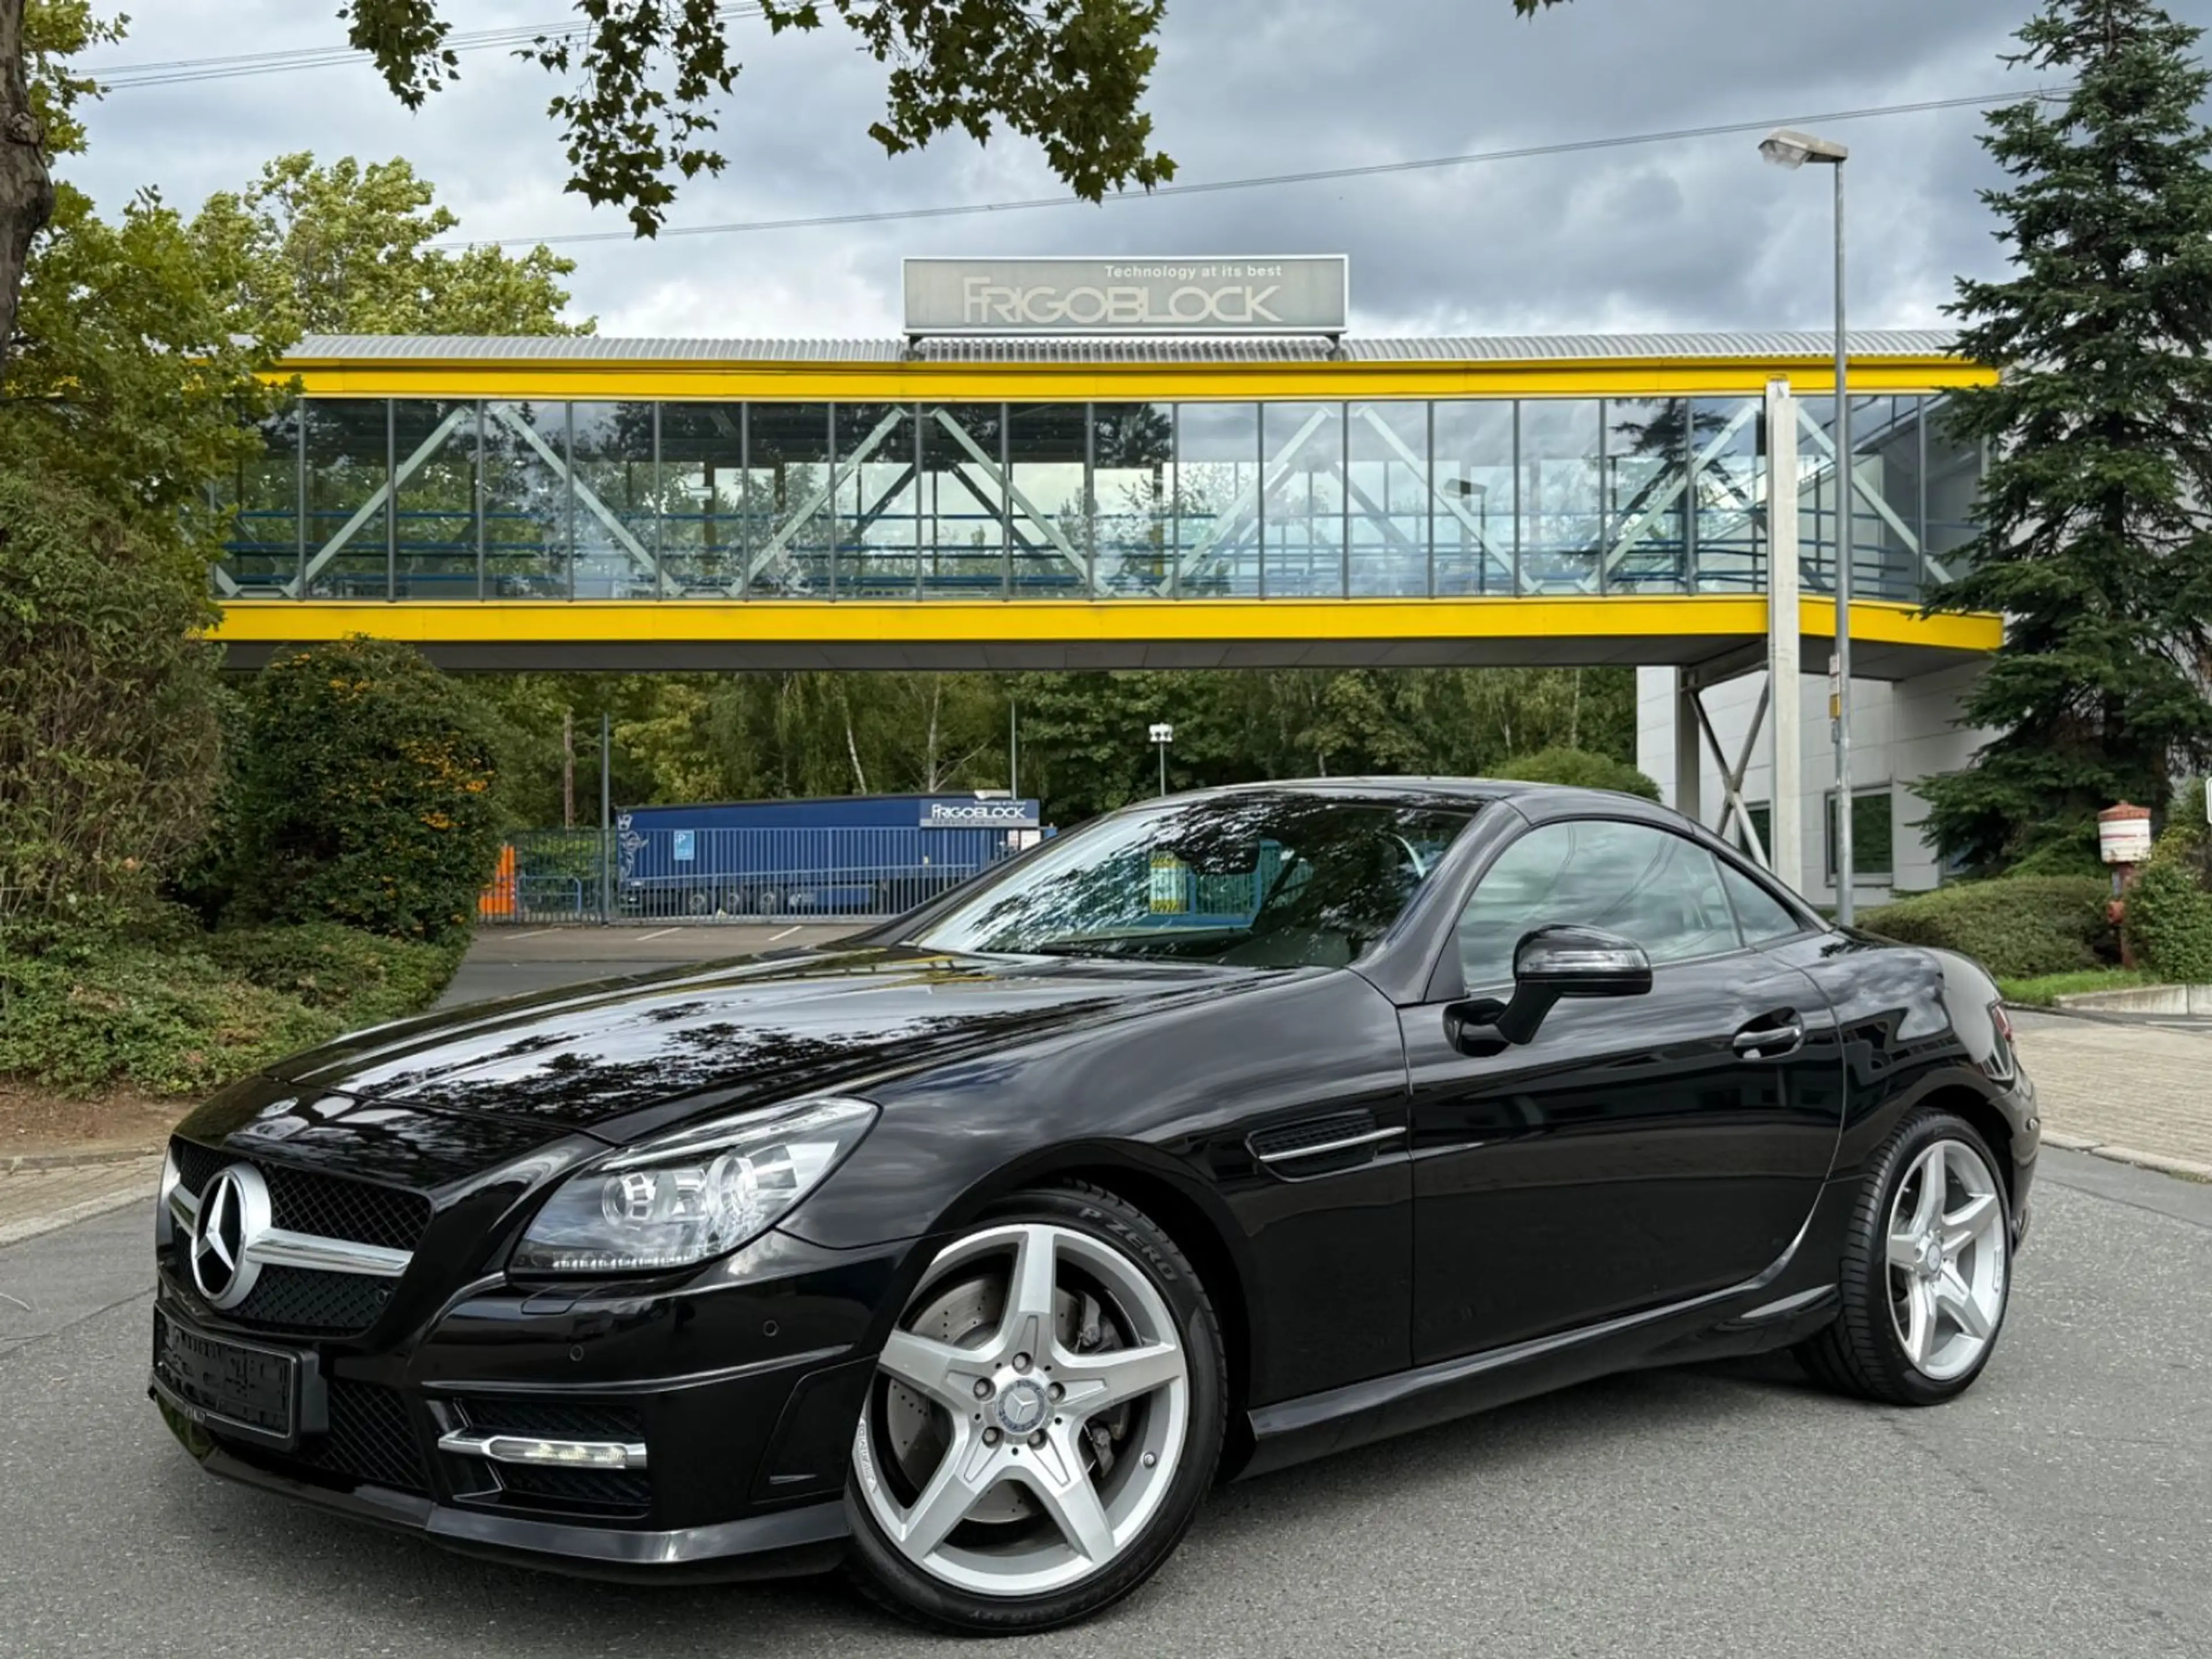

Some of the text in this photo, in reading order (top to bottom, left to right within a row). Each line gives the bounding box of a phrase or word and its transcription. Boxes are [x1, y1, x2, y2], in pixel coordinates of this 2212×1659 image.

[1104, 264, 1282, 279] Technology at its best
[963, 275, 1283, 323] FRIGOBLOCK
[1079, 1207, 1177, 1280] P ZERO
